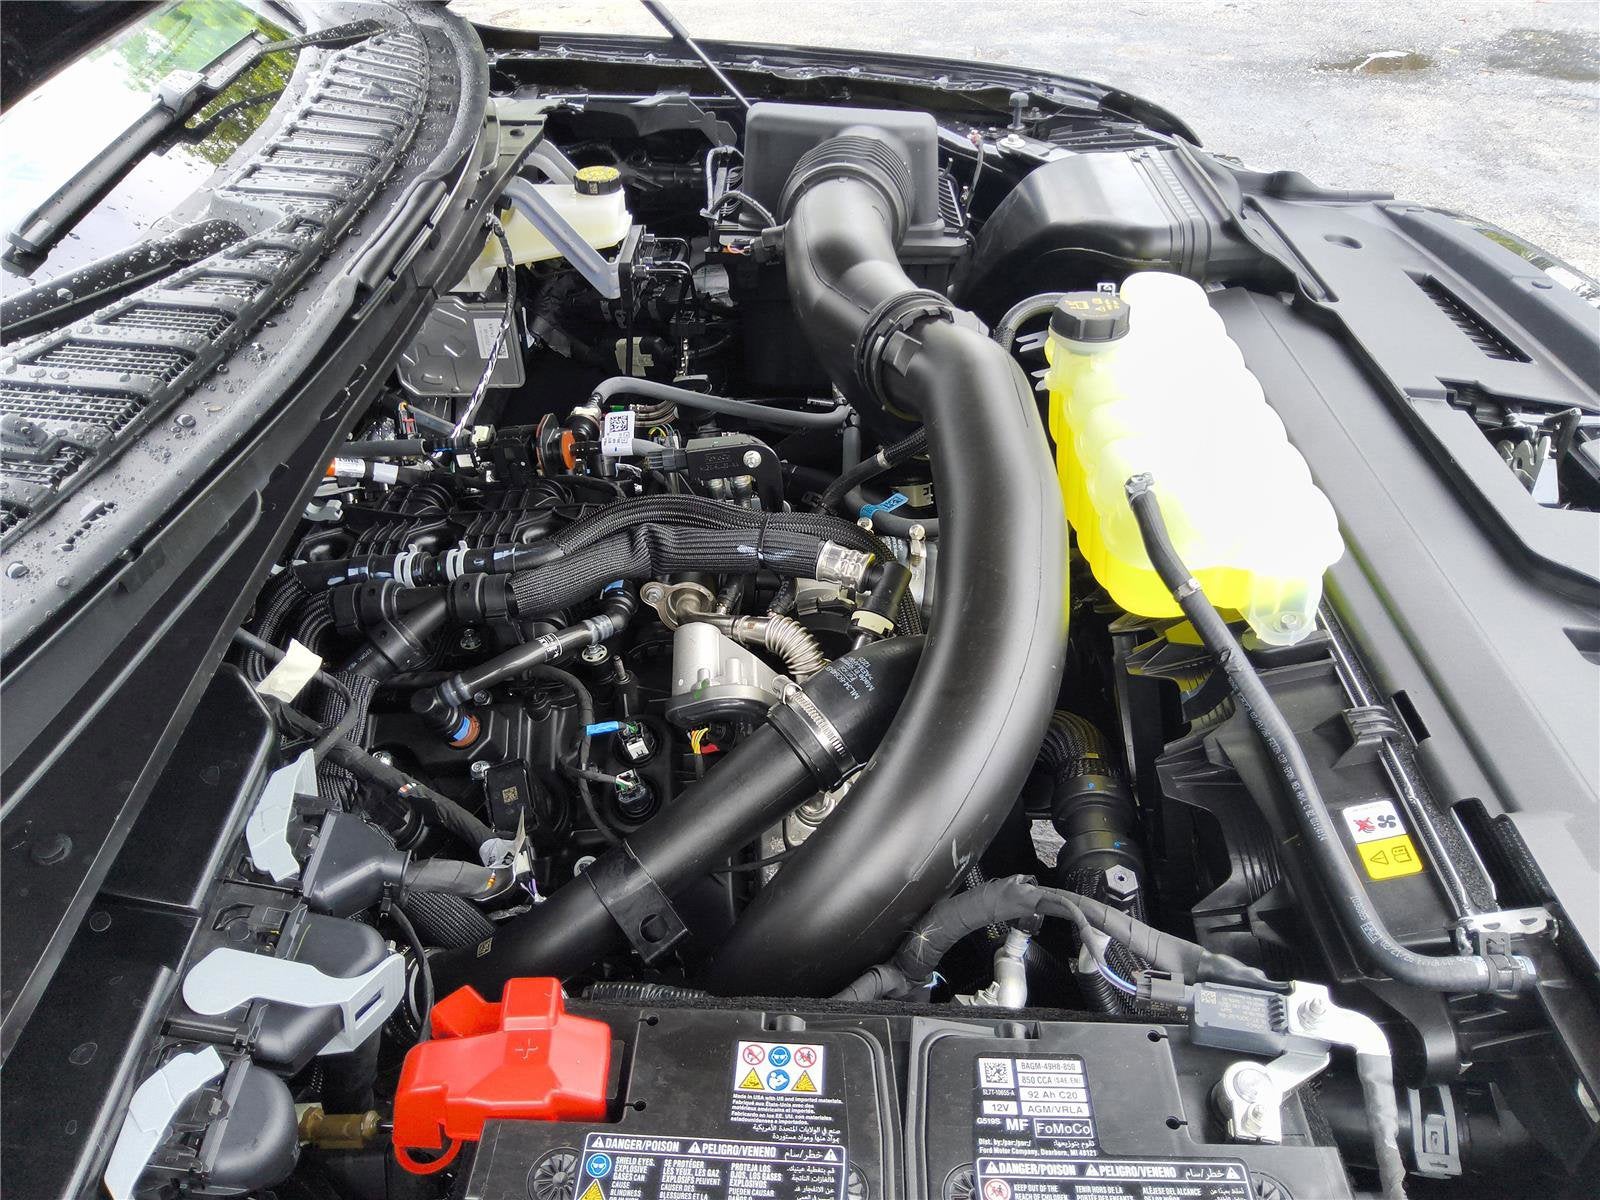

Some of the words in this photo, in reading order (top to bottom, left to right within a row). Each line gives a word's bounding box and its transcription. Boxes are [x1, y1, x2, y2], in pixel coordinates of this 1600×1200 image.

[1022, 1076, 1035, 1084] 850
[992, 1103, 1009, 1112] 12V
[1028, 1105, 1083, 1114] AGM/VRLA
[1006, 1118, 1028, 1130] MF
[1037, 1123, 1090, 1135] FoMoCo
[605, 1138, 679, 1152] DANGER/POISON
[702, 1143, 777, 1158] PELIGRO/VENENO
[616, 1156, 637, 1164] SHIELD
[638, 1158, 655, 1166] EYES.
[673, 1158, 704, 1168] PROTÉGER
[614, 1164, 648, 1174] EXPLOSIVE
[731, 1163, 758, 1171] PROTEJA
[759, 1164, 771, 1172] LOS
[999, 1162, 1077, 1175] DANGER/POISON
[1099, 1165, 1176, 1178] PELIGRO/VENENO
[613, 1172, 633, 1181] GASES
[707, 1169, 720, 1177] GAZ
[762, 1173, 782, 1181] GASES
[661, 1175, 695, 1184] EXPLOSIFS
[729, 1179, 768, 1188] EXPLOSIVOS
[610, 1189, 642, 1197] BLINDNESS
[659, 1191, 692, 1199] BLESSURES
[752, 1189, 775, 1197] CAUSAR
[1177, 1188, 1202, 1196] ALCANCE
